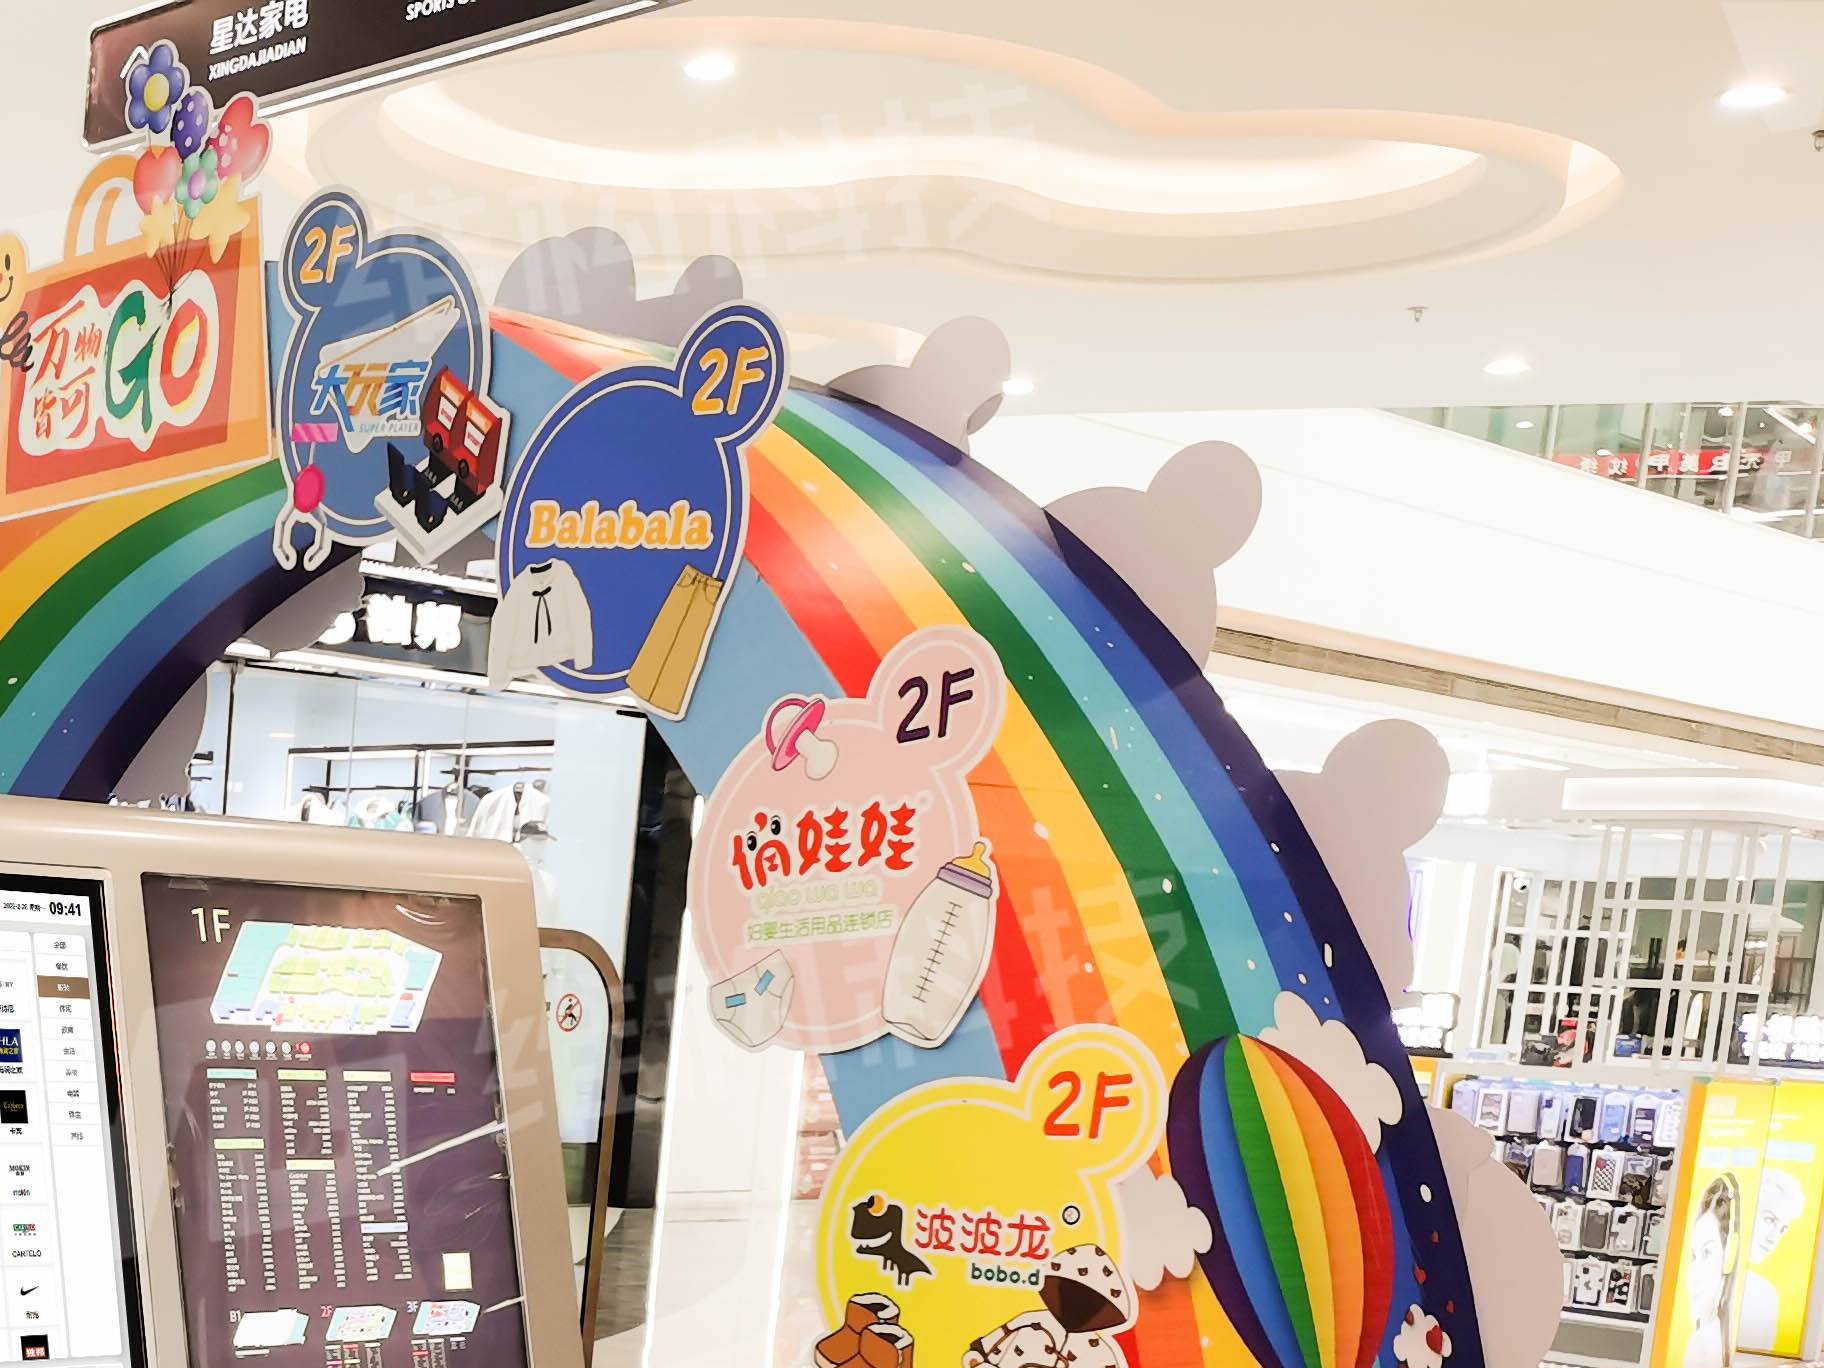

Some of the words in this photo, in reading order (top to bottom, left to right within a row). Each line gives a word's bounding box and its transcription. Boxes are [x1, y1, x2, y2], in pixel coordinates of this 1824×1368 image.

[210, 0, 308, 54] 星达家电
[208, 37, 307, 81] XINGDAJIADIAN
[299, 216, 356, 284] 2F
[311, 360, 432, 432] 大玩家
[691, 346, 770, 415] 2F
[526, 500, 712, 549] Balabala
[897, 668, 975, 743] 2F
[732, 801, 916, 890] 俏娃娃
[49, 901, 82, 917] 09:41
[192, 907, 232, 944] 1F
[1044, 1071, 1133, 1139] 2F
[914, 1208, 1050, 1260] 波波龙
[971, 1263, 1040, 1286] bobo.d
[321, 1305, 332, 1318] 2F
[407, 1301, 418, 1313] 3F
